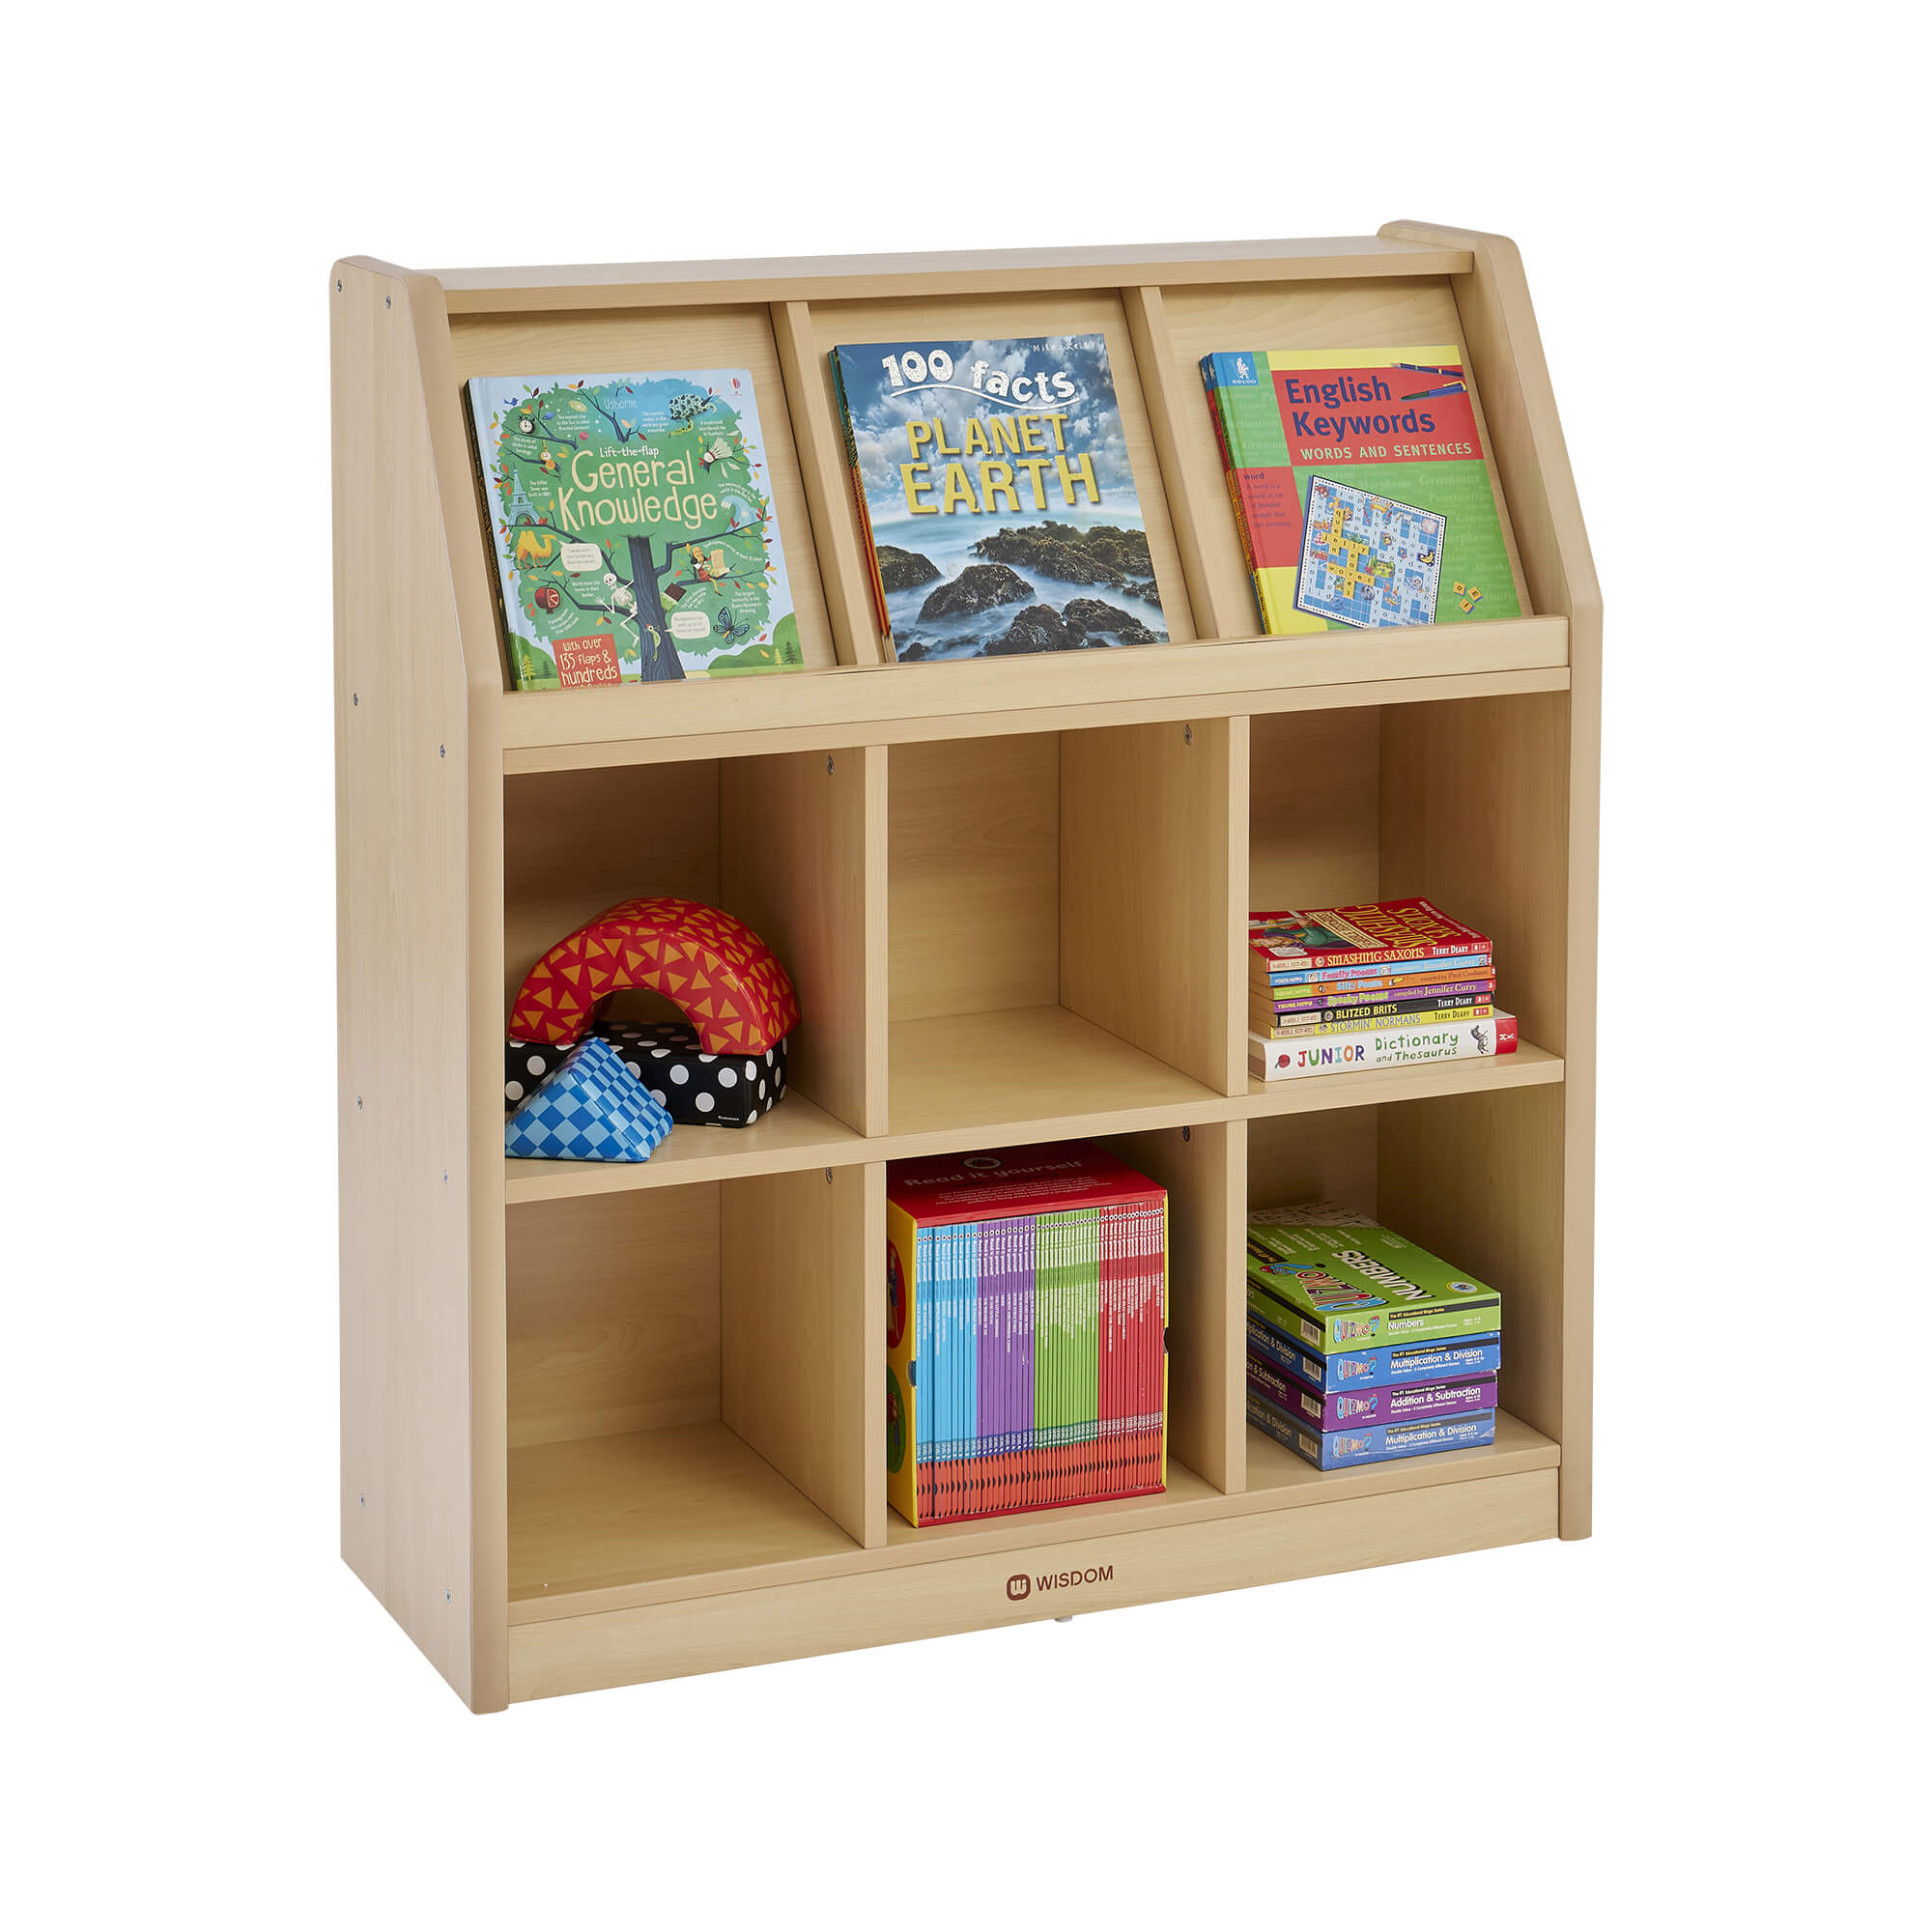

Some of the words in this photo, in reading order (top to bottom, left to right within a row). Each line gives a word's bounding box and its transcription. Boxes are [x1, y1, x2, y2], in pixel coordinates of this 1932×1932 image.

[882, 349, 954, 387] 100
[970, 359, 1076, 404] facts
[1285, 376, 1391, 410] English
[905, 413, 1068, 459] PLANET
[1292, 409, 1435, 442] Keywords
[599, 445, 660, 459] Lift-the-flap
[1300, 446, 1352, 461] WORDS
[1359, 445, 1387, 459] AND
[1394, 442, 1473, 458] SENTENCES
[571, 449, 695, 493] General
[899, 453, 1101, 515] EARTH
[557, 486, 718, 532] Knowledge
[559, 652, 576, 670] 135
[578, 653, 602, 666] flaps
[601, 648, 611, 664] &
[560, 664, 618, 686] hundreds
[1326, 951, 1382, 966] SMASHING
[1384, 947, 1425, 961] SAXONS
[1432, 946, 1449, 955] TERRY
[1450, 945, 1468, 953] DEARY
[1321, 971, 1350, 981] Family
[1350, 968, 1378, 979] Poems
[1424, 984, 1454, 996] Jennifer
[1454, 983, 1477, 992] Curry
[1336, 1007, 1370, 1019] BLITZED
[1373, 1005, 1398, 1015] BRITS
[1436, 998, 1455, 1008] TERRY
[1455, 997, 1472, 1006] DEARY
[1376, 1014, 1421, 1028] NORMANS
[1435, 1011, 1451, 1021] TERRY
[1452, 1010, 1470, 1019] DEARY
[1376, 1033, 1459, 1051] Dictionary
[1297, 1044, 1365, 1067] JUNIOR
[1376, 1054, 1392, 1063] and
[1395, 1046, 1458, 1062] Thesaurus
[903, 1173, 963, 1186] Read
[970, 1170, 989, 1179] it
[993, 1159, 1083, 1177] yourself
[1332, 1250, 1434, 1300] NUMBERS
[1387, 1320, 1424, 1330] Numbers
[1390, 1354, 1442, 1370] Multiplication
[1444, 1352, 1451, 1361] &
[1453, 1349, 1483, 1360] Division
[1390, 1396, 1425, 1408] Addition
[1426, 1393, 1434, 1403] &
[1435, 1387, 1481, 1401] Subtraction
[1385, 1432, 1436, 1446] Multiplication
[1438, 1428, 1445, 1437] &
[1447, 1424, 1477, 1435] Division
[1037, 1565, 1113, 1591] WISDOM
